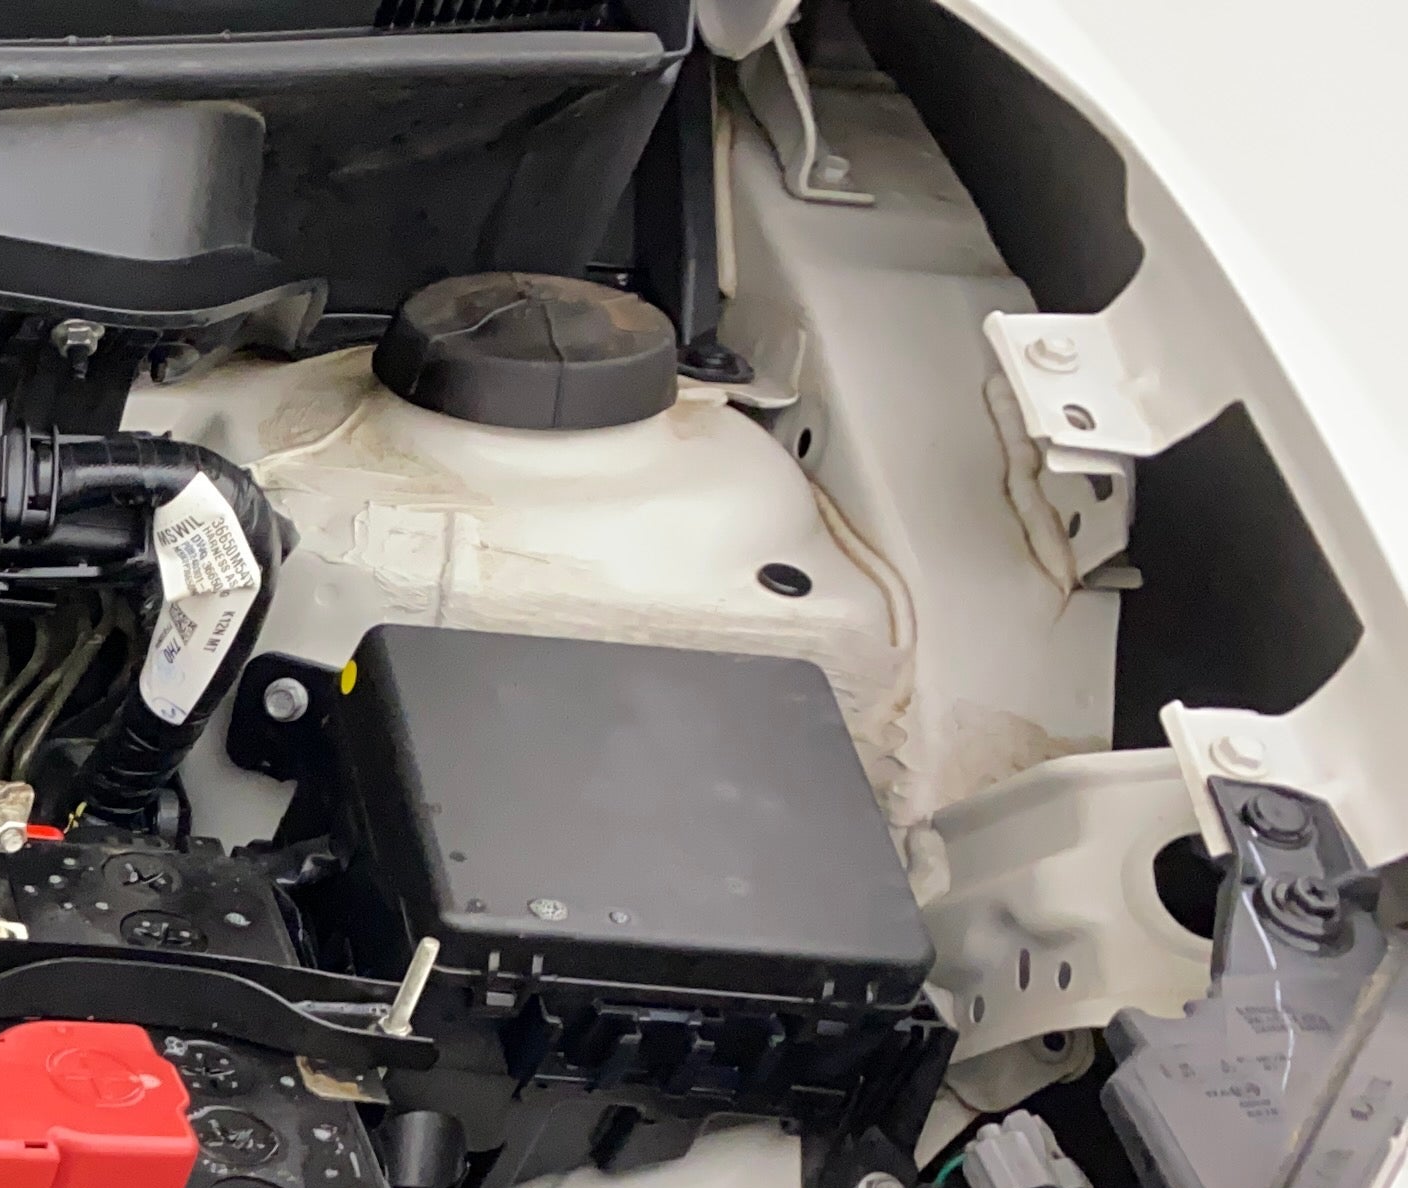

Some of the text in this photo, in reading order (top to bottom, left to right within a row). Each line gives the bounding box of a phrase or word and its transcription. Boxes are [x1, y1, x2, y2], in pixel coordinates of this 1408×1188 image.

[156, 515, 205, 547] MSWIL
[203, 526, 231, 573] HARNESS
[204, 611, 236, 652] K12N MT
